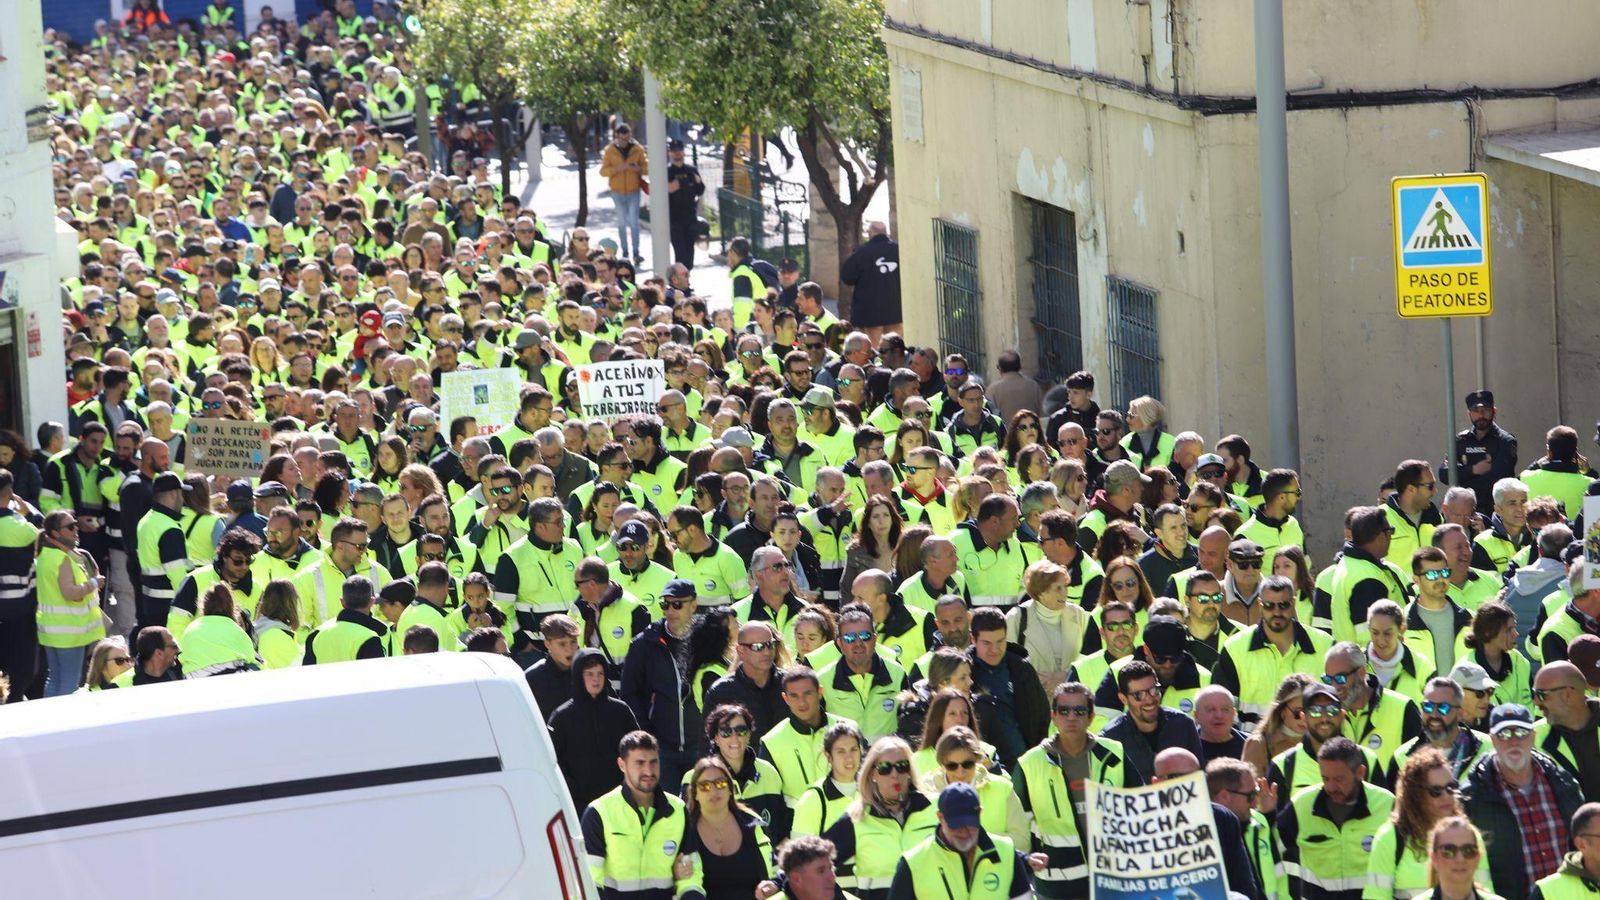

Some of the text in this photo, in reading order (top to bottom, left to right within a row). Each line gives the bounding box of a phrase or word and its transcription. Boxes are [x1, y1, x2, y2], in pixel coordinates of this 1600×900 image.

[1409, 271, 1479, 288] PASO DE
[1403, 292, 1488, 308] PEATONES
[594, 363, 663, 382] ACERINOX
[603, 383, 645, 398] A TUS
[196, 425, 208, 434] NO
[214, 426, 225, 435] AL
[191, 437, 262, 450] LOS DESCANSOS
[208, 448, 250, 459] SON PARA
[195, 459, 222, 468] JUGAR
[225, 460, 240, 469] CON
[1096, 781, 1198, 817] ACERINOX
[1102, 810, 1190, 837] ESCUCHA
[1096, 844, 1216, 872] EN LA LUCHA
[1096, 867, 1219, 892] FAMILIAS DE ACERO
